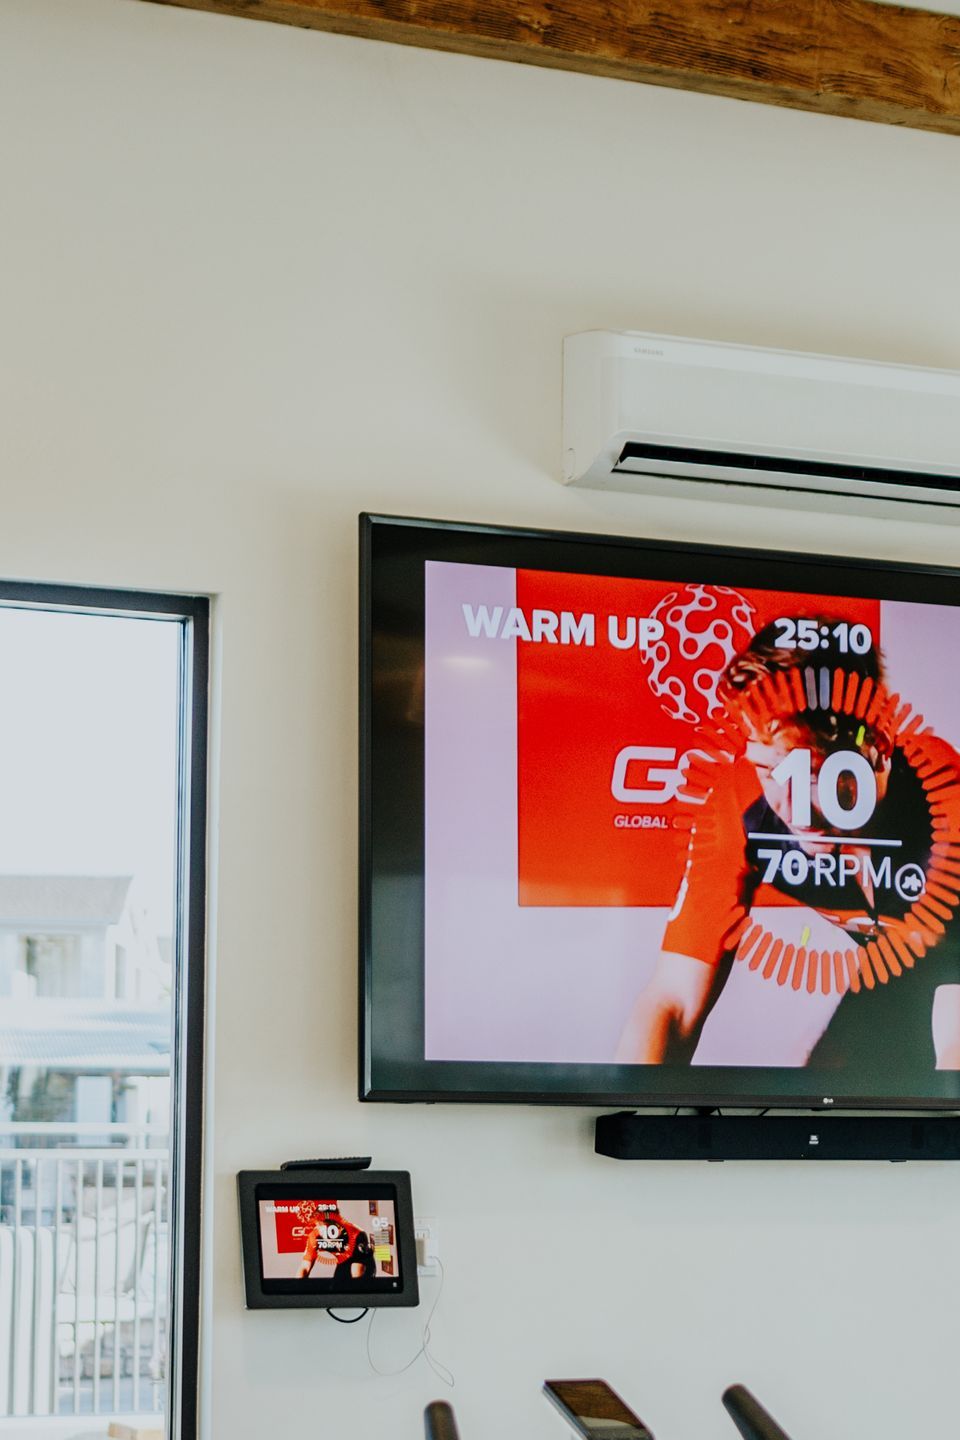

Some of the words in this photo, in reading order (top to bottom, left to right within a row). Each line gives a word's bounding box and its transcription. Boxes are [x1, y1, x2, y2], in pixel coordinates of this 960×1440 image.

[462, 602, 596, 647] WARM
[608, 614, 665, 651] UP
[773, 617, 873, 655] 25:10
[611, 745, 716, 805] GC
[770, 747, 877, 831] 10
[614, 814, 668, 829] GLOBAL
[757, 848, 809, 885] 70
[814, 851, 892, 889] RPM
[318, 1224, 339, 1239] 10
